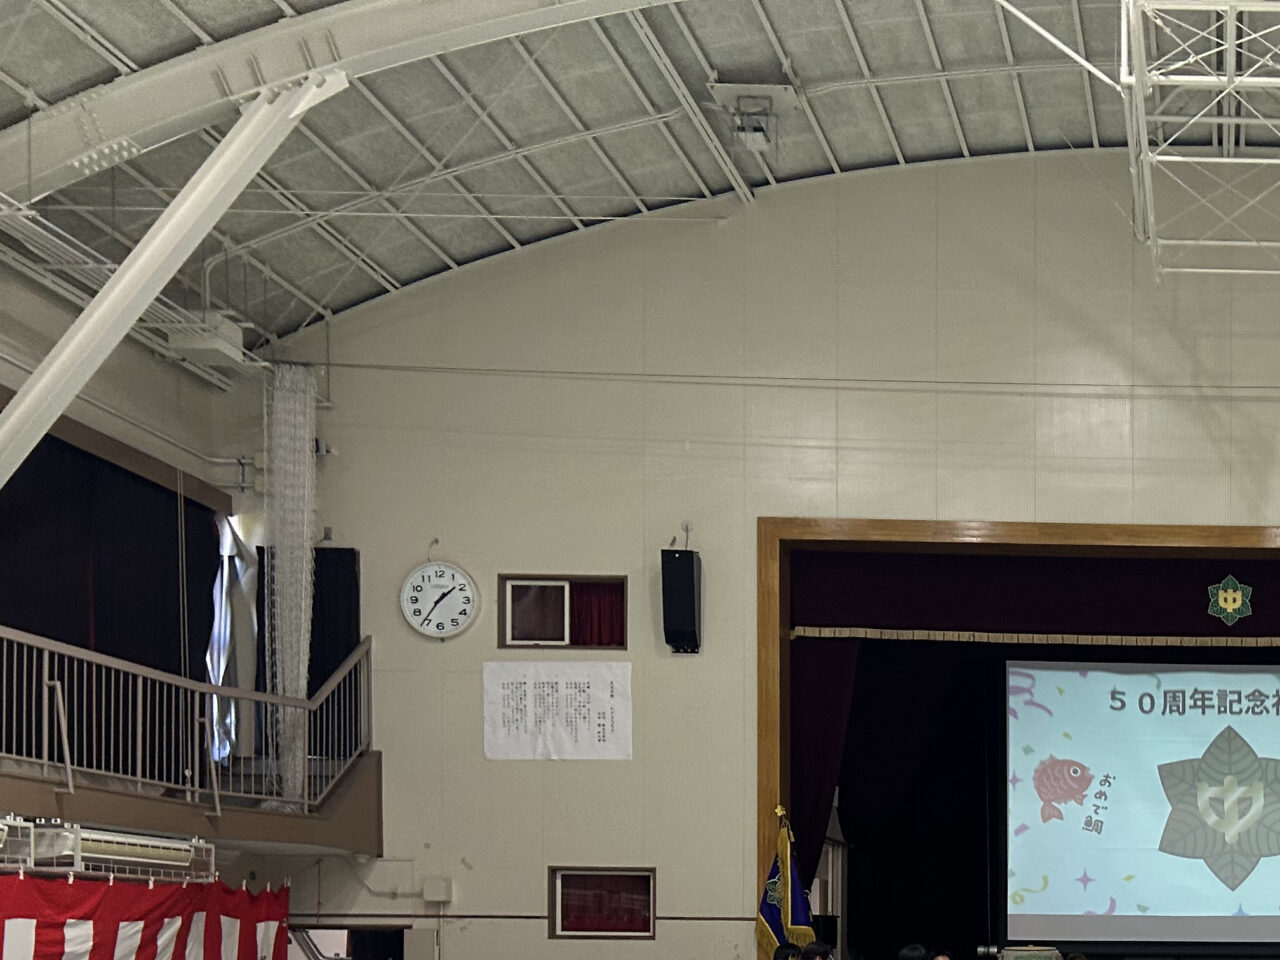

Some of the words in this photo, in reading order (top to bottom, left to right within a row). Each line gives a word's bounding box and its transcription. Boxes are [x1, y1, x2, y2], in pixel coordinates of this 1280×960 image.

[434, 570, 446, 578] 12
[421, 575, 431, 583] 11
[458, 584, 466, 592] 2
[410, 596, 418, 604] 9
[462, 596, 471, 604] 3
[413, 608, 422, 616] 8
[458, 608, 467, 616] 4
[424, 618, 432, 626] 7
[436, 622, 445, 630] 6
[451, 618, 460, 626] 5
[1082, 772, 1117, 836] おめで鯛
